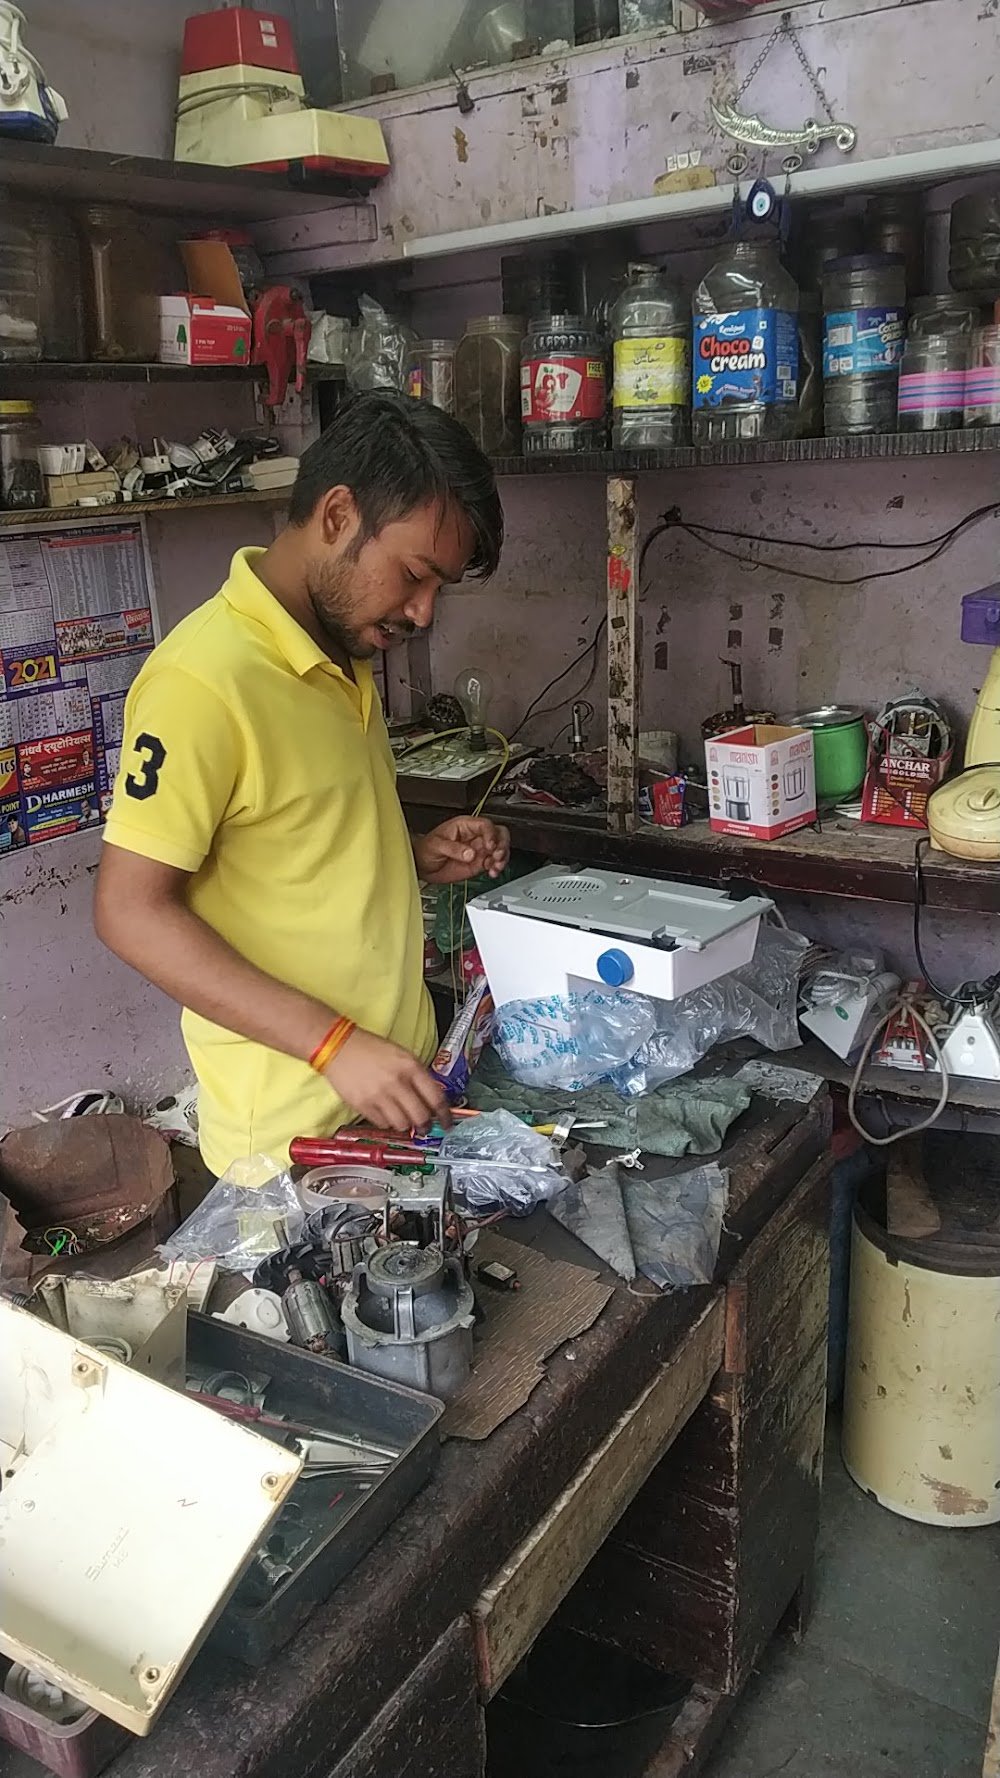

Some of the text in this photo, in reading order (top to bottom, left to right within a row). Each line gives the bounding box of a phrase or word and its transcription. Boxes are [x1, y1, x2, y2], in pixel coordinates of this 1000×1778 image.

[700, 336, 750, 357] Choco
[711, 353, 766, 373] cream
[8, 655, 57, 686] 2021
[125, 732, 167, 801] 3
[880, 758, 930, 772] ANCHAR
[893, 769, 916, 777] GOLD
[1, 800, 20, 814] POINT
[26, 782, 95, 814] DHARMESH
